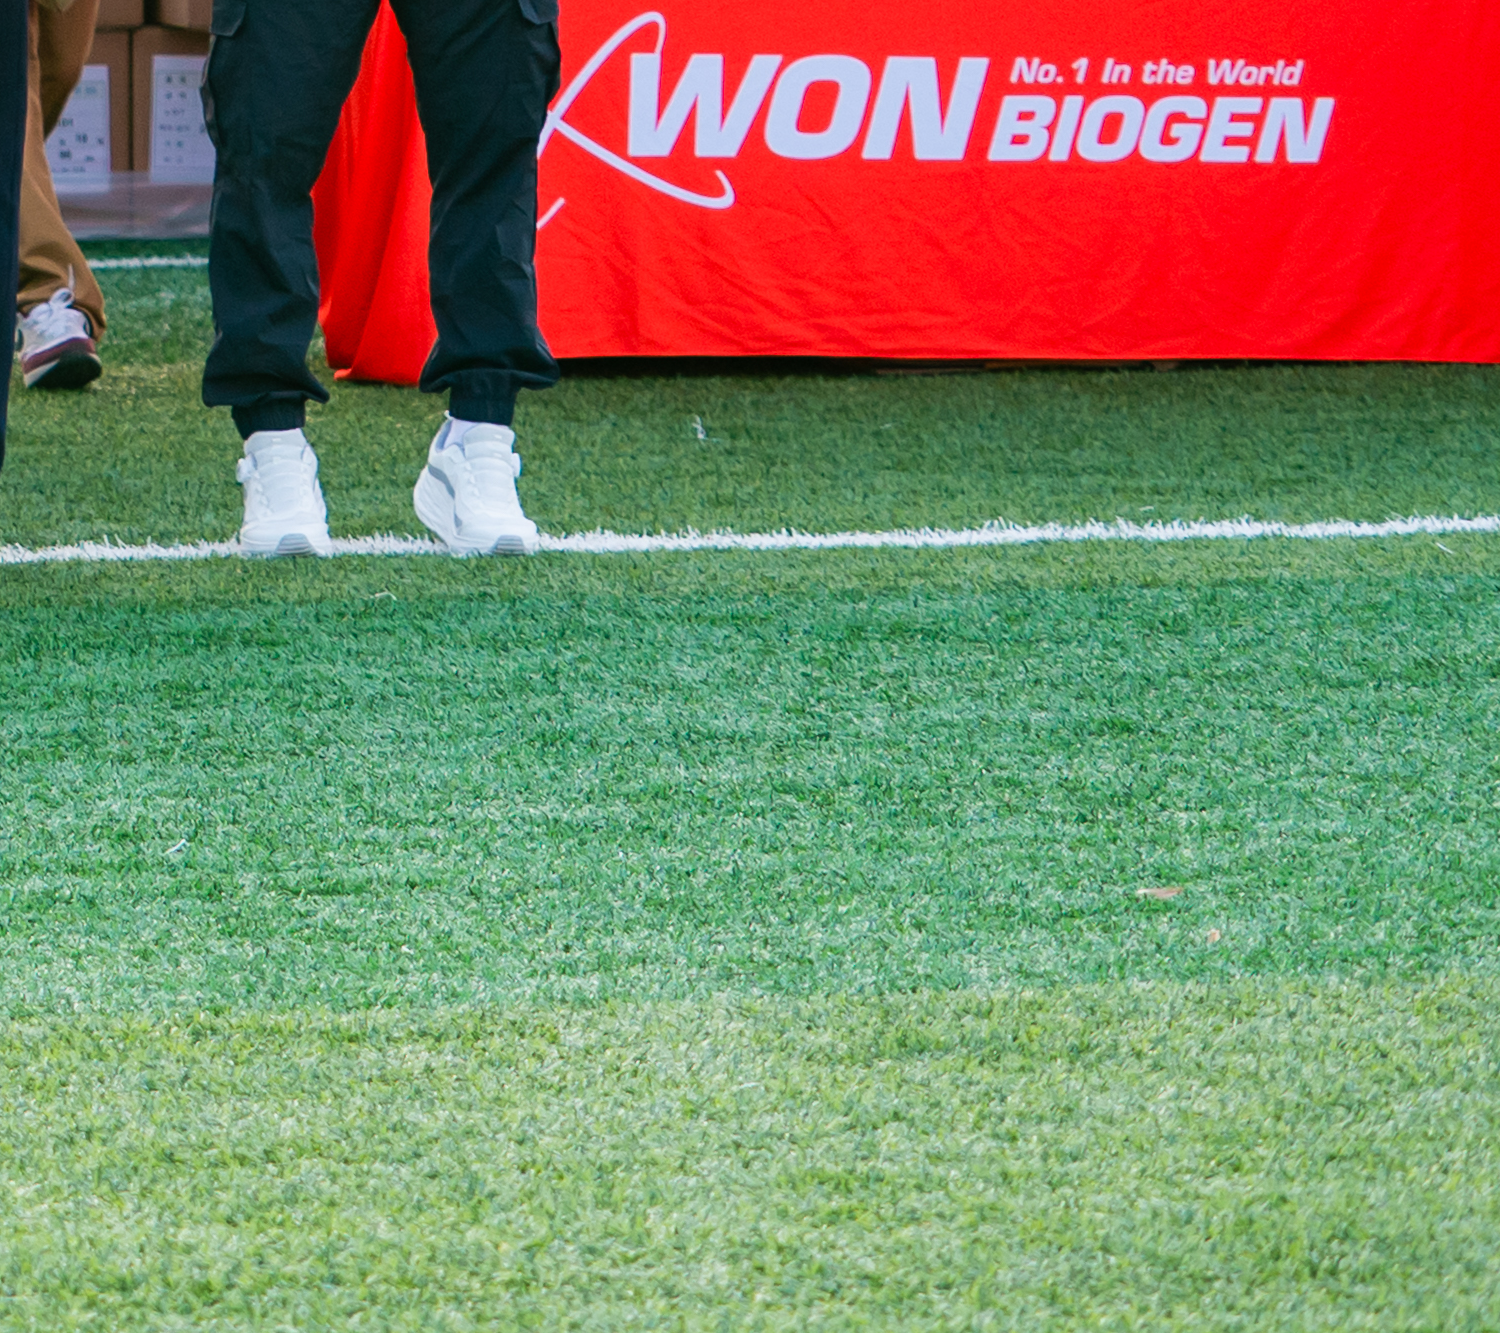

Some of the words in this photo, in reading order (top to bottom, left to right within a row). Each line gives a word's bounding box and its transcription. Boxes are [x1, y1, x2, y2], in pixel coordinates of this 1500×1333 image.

[1102, 58, 1130, 85] In
[1141, 58, 1195, 86] the
[1206, 58, 1304, 87] World
[627, 53, 990, 161] WON
[988, 95, 1335, 164] BIOGEN
